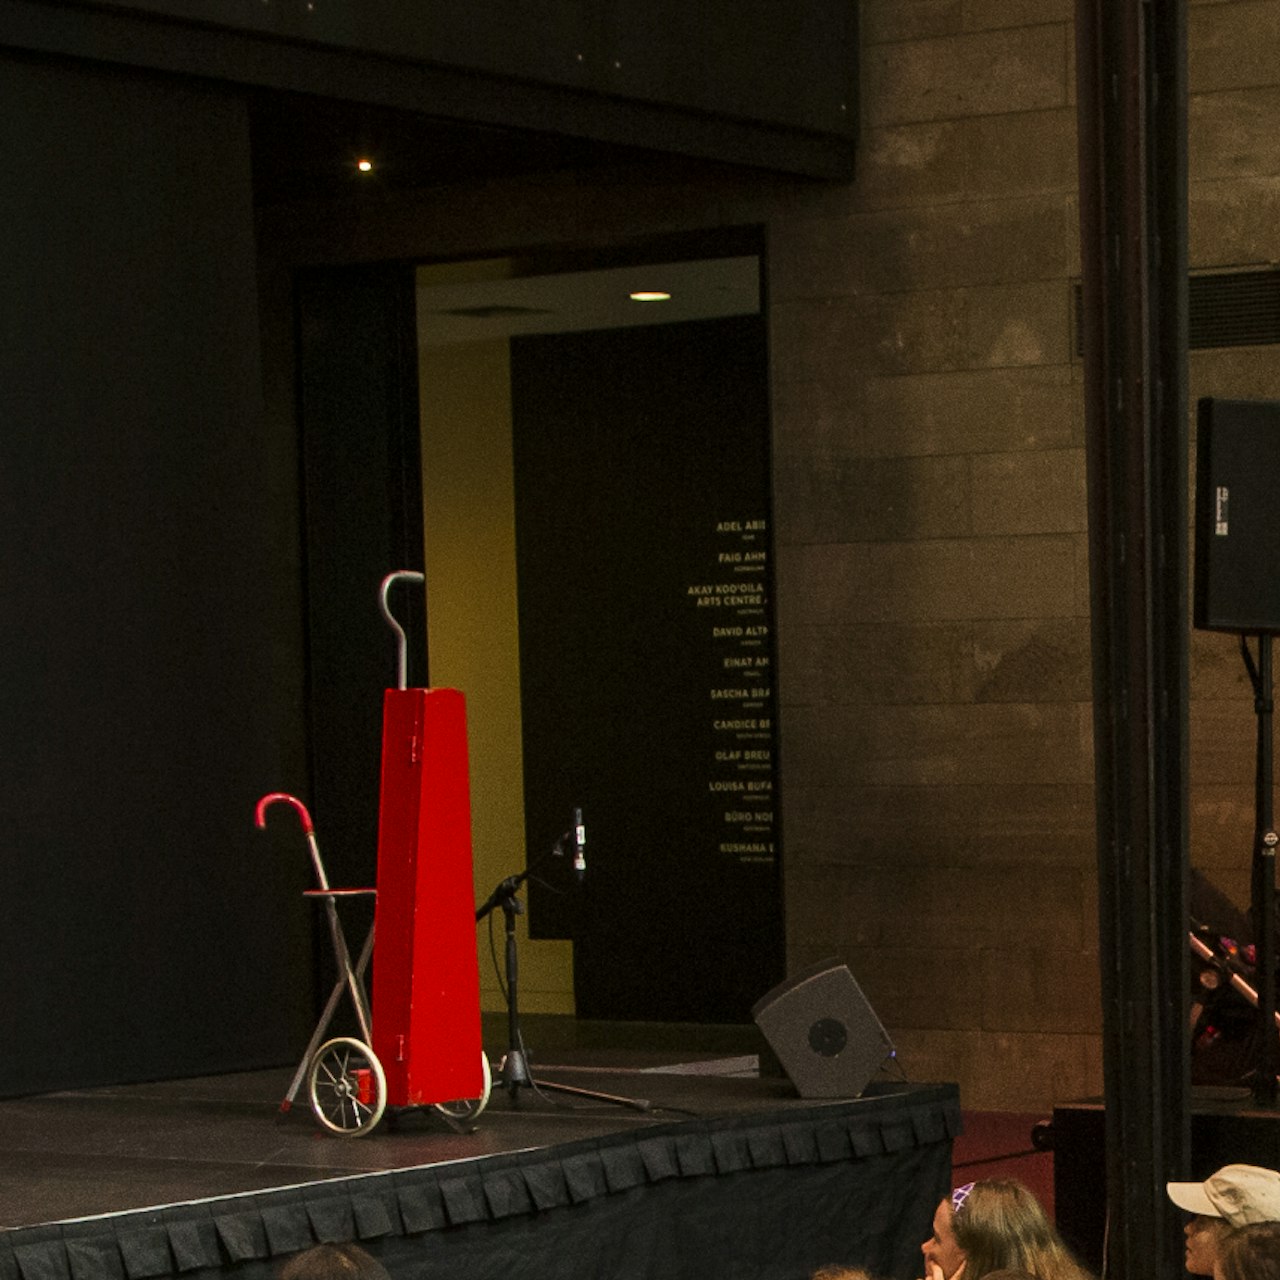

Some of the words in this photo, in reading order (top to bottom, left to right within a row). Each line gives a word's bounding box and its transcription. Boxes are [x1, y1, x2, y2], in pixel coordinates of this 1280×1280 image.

[716, 521, 742, 532] ADEL
[696, 596, 721, 607] ARTS
[723, 595, 762, 606] CENTRE
[713, 627, 743, 637] DAVID
[710, 689, 749, 699] SASCHA
[713, 719, 757, 730] CANDICE
[715, 750, 741, 760] OLAF
[709, 781, 745, 791] LOUISA
